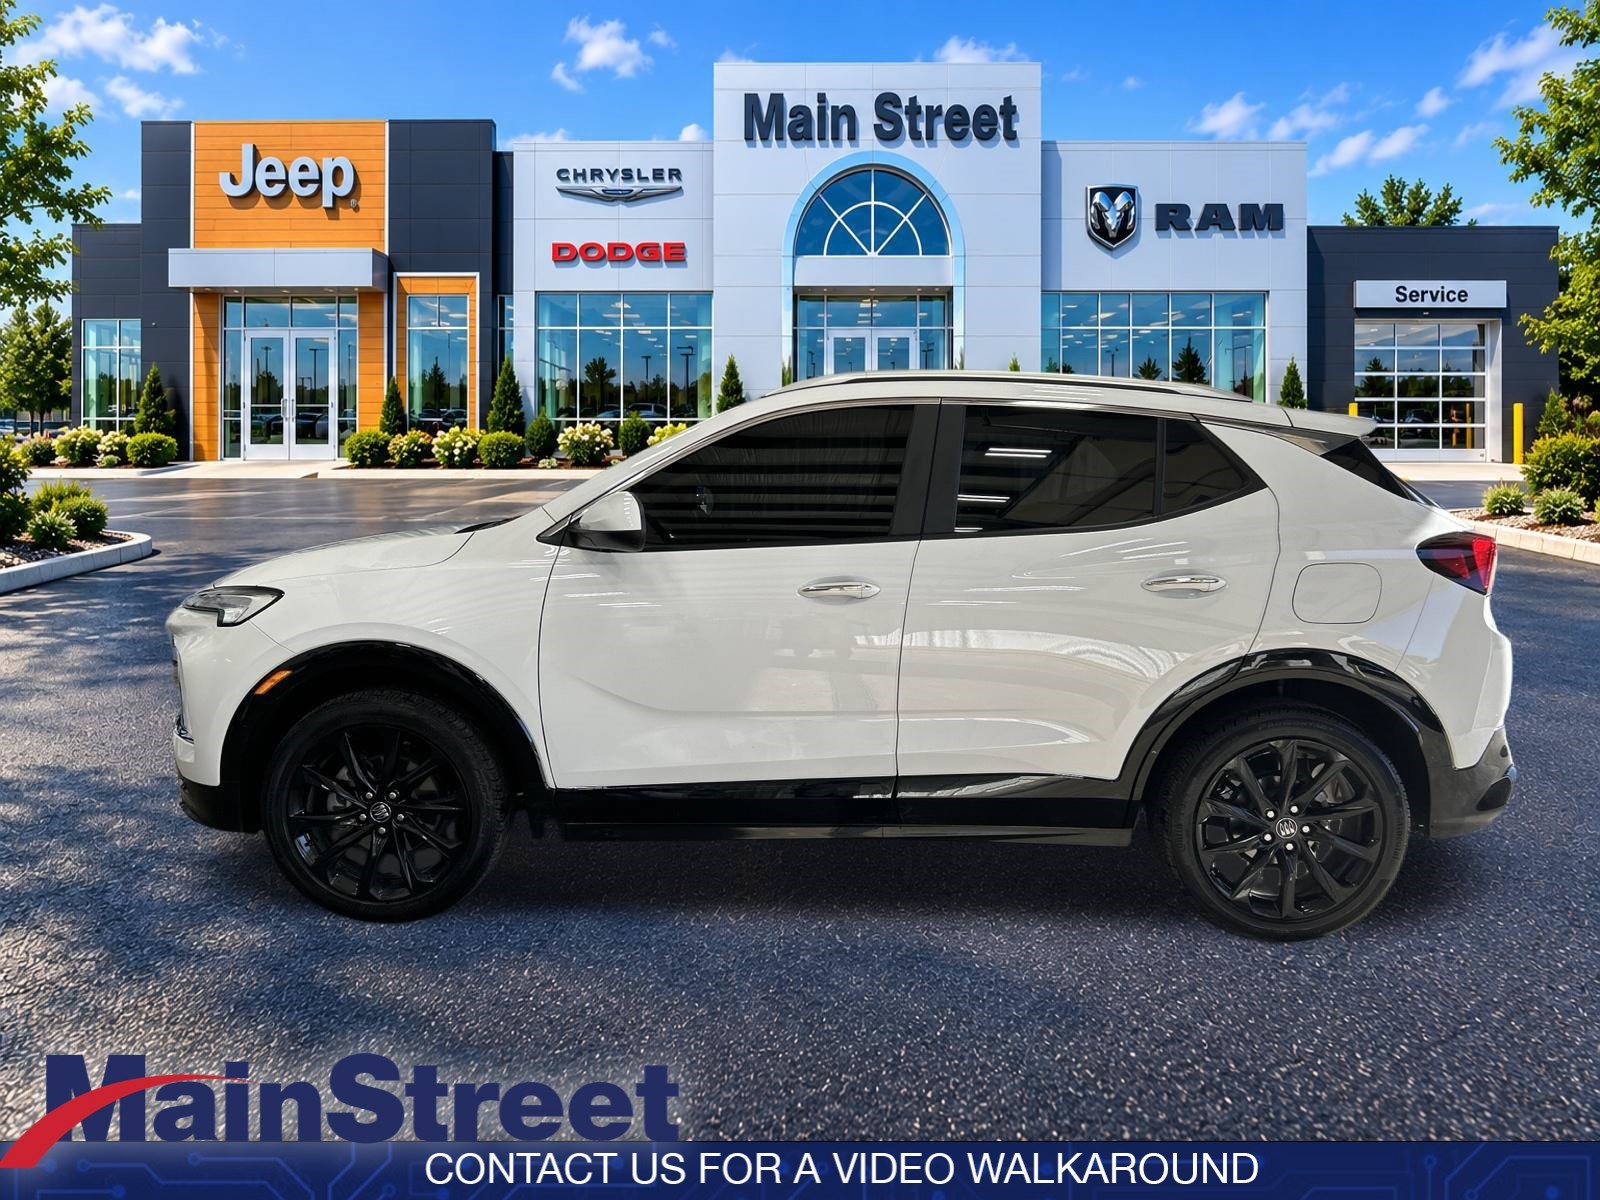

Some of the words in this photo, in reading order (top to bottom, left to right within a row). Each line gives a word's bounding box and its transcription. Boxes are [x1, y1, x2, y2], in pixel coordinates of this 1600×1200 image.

[744, 92, 858, 143] Main
[873, 91, 1018, 143] Street
[218, 143, 355, 209] Jeep
[556, 168, 682, 182] CHRYSLER
[1155, 203, 1284, 232] RAM
[551, 242, 686, 263] DODGE
[1395, 285, 1468, 303] Service
